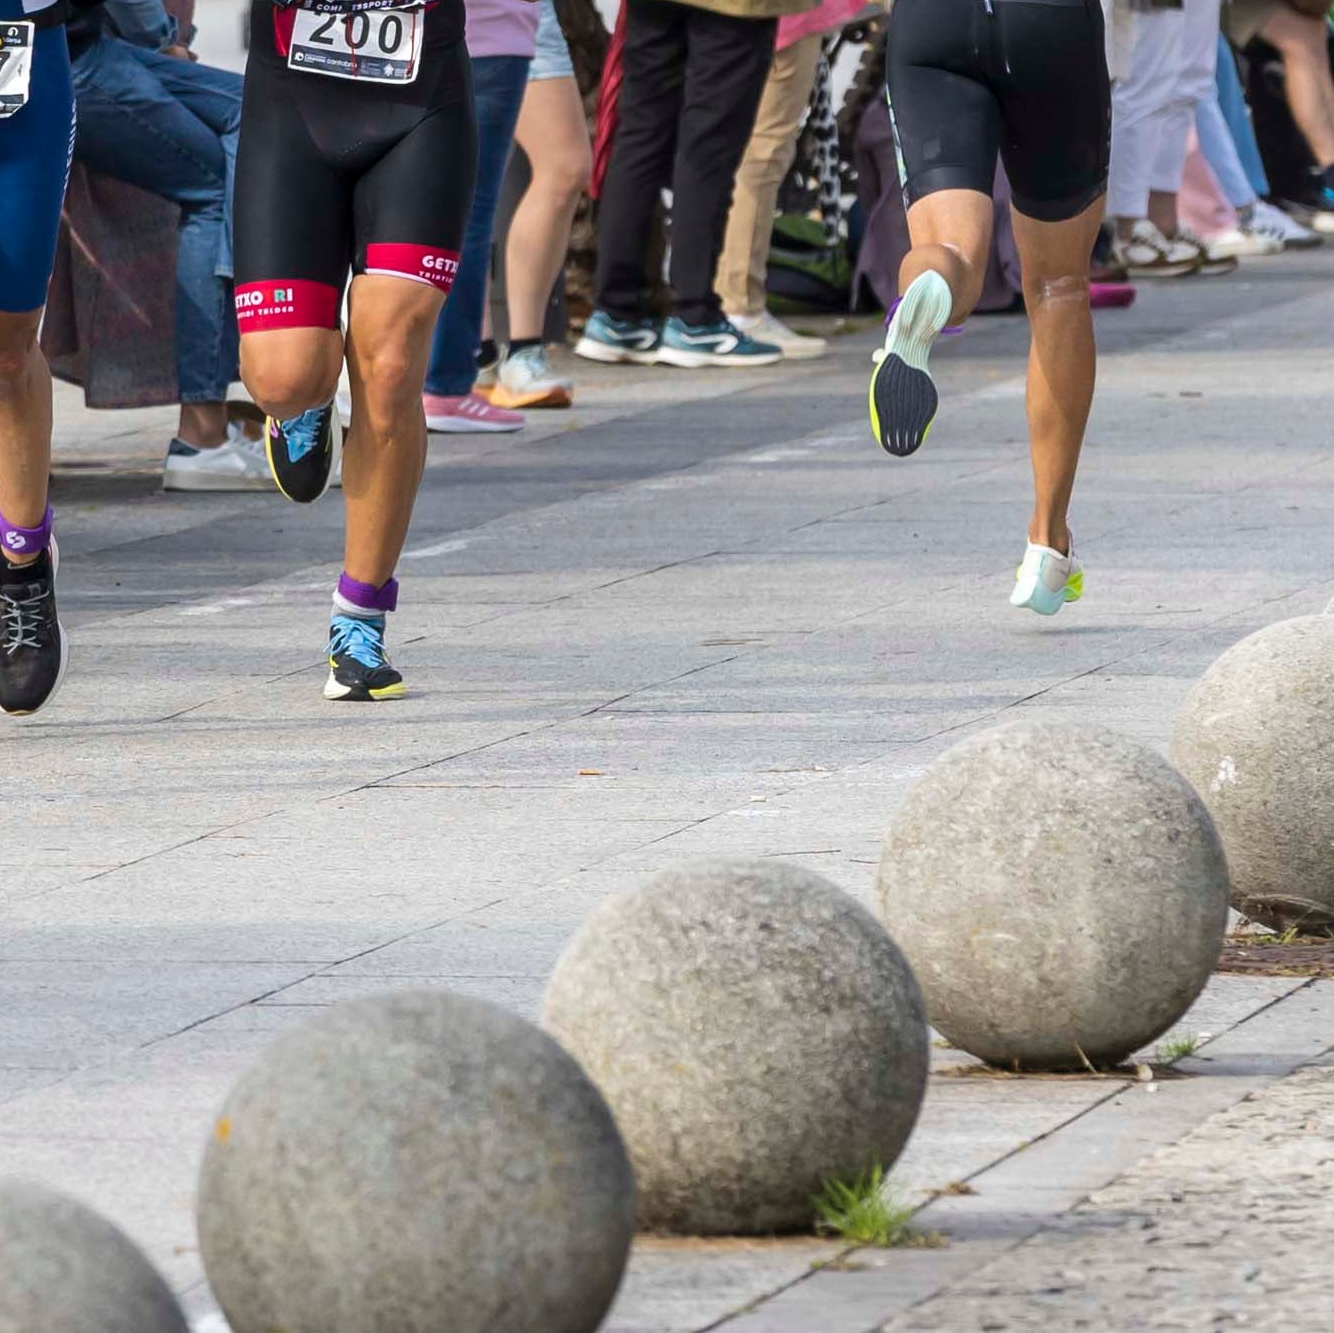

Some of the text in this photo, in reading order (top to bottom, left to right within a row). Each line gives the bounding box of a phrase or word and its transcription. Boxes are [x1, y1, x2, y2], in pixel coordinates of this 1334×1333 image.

[309, 10, 402, 54] 200
[422, 254, 459, 274] GETX
[235, 290, 264, 308] ETXO
